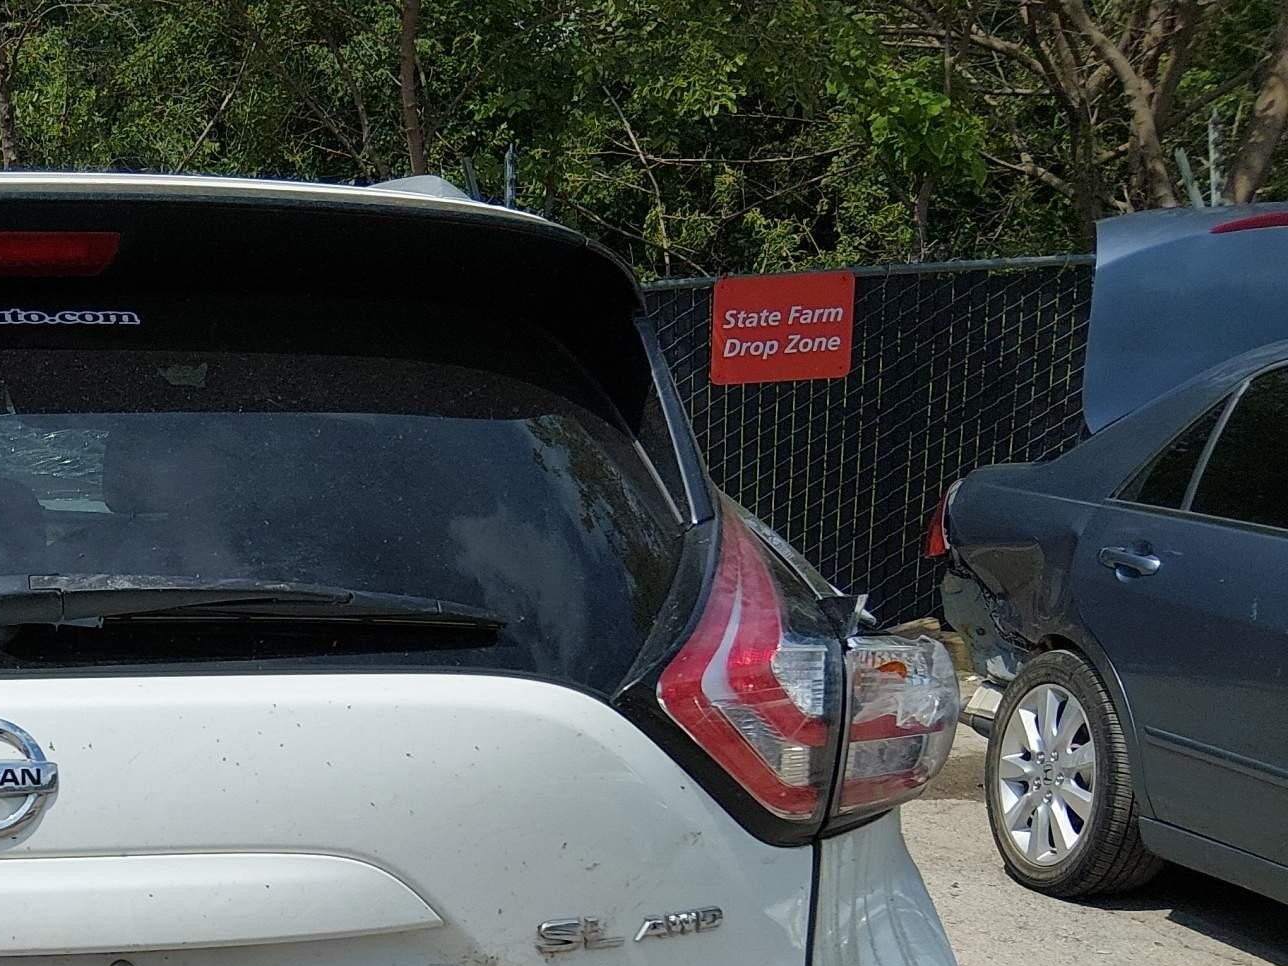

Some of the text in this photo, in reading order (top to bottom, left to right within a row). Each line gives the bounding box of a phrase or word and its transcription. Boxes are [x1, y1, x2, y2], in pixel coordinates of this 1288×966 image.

[722, 305, 843, 329] State Farm
[723, 334, 841, 360] Drop Zone
[536, 905, 724, 954] SL AWD
